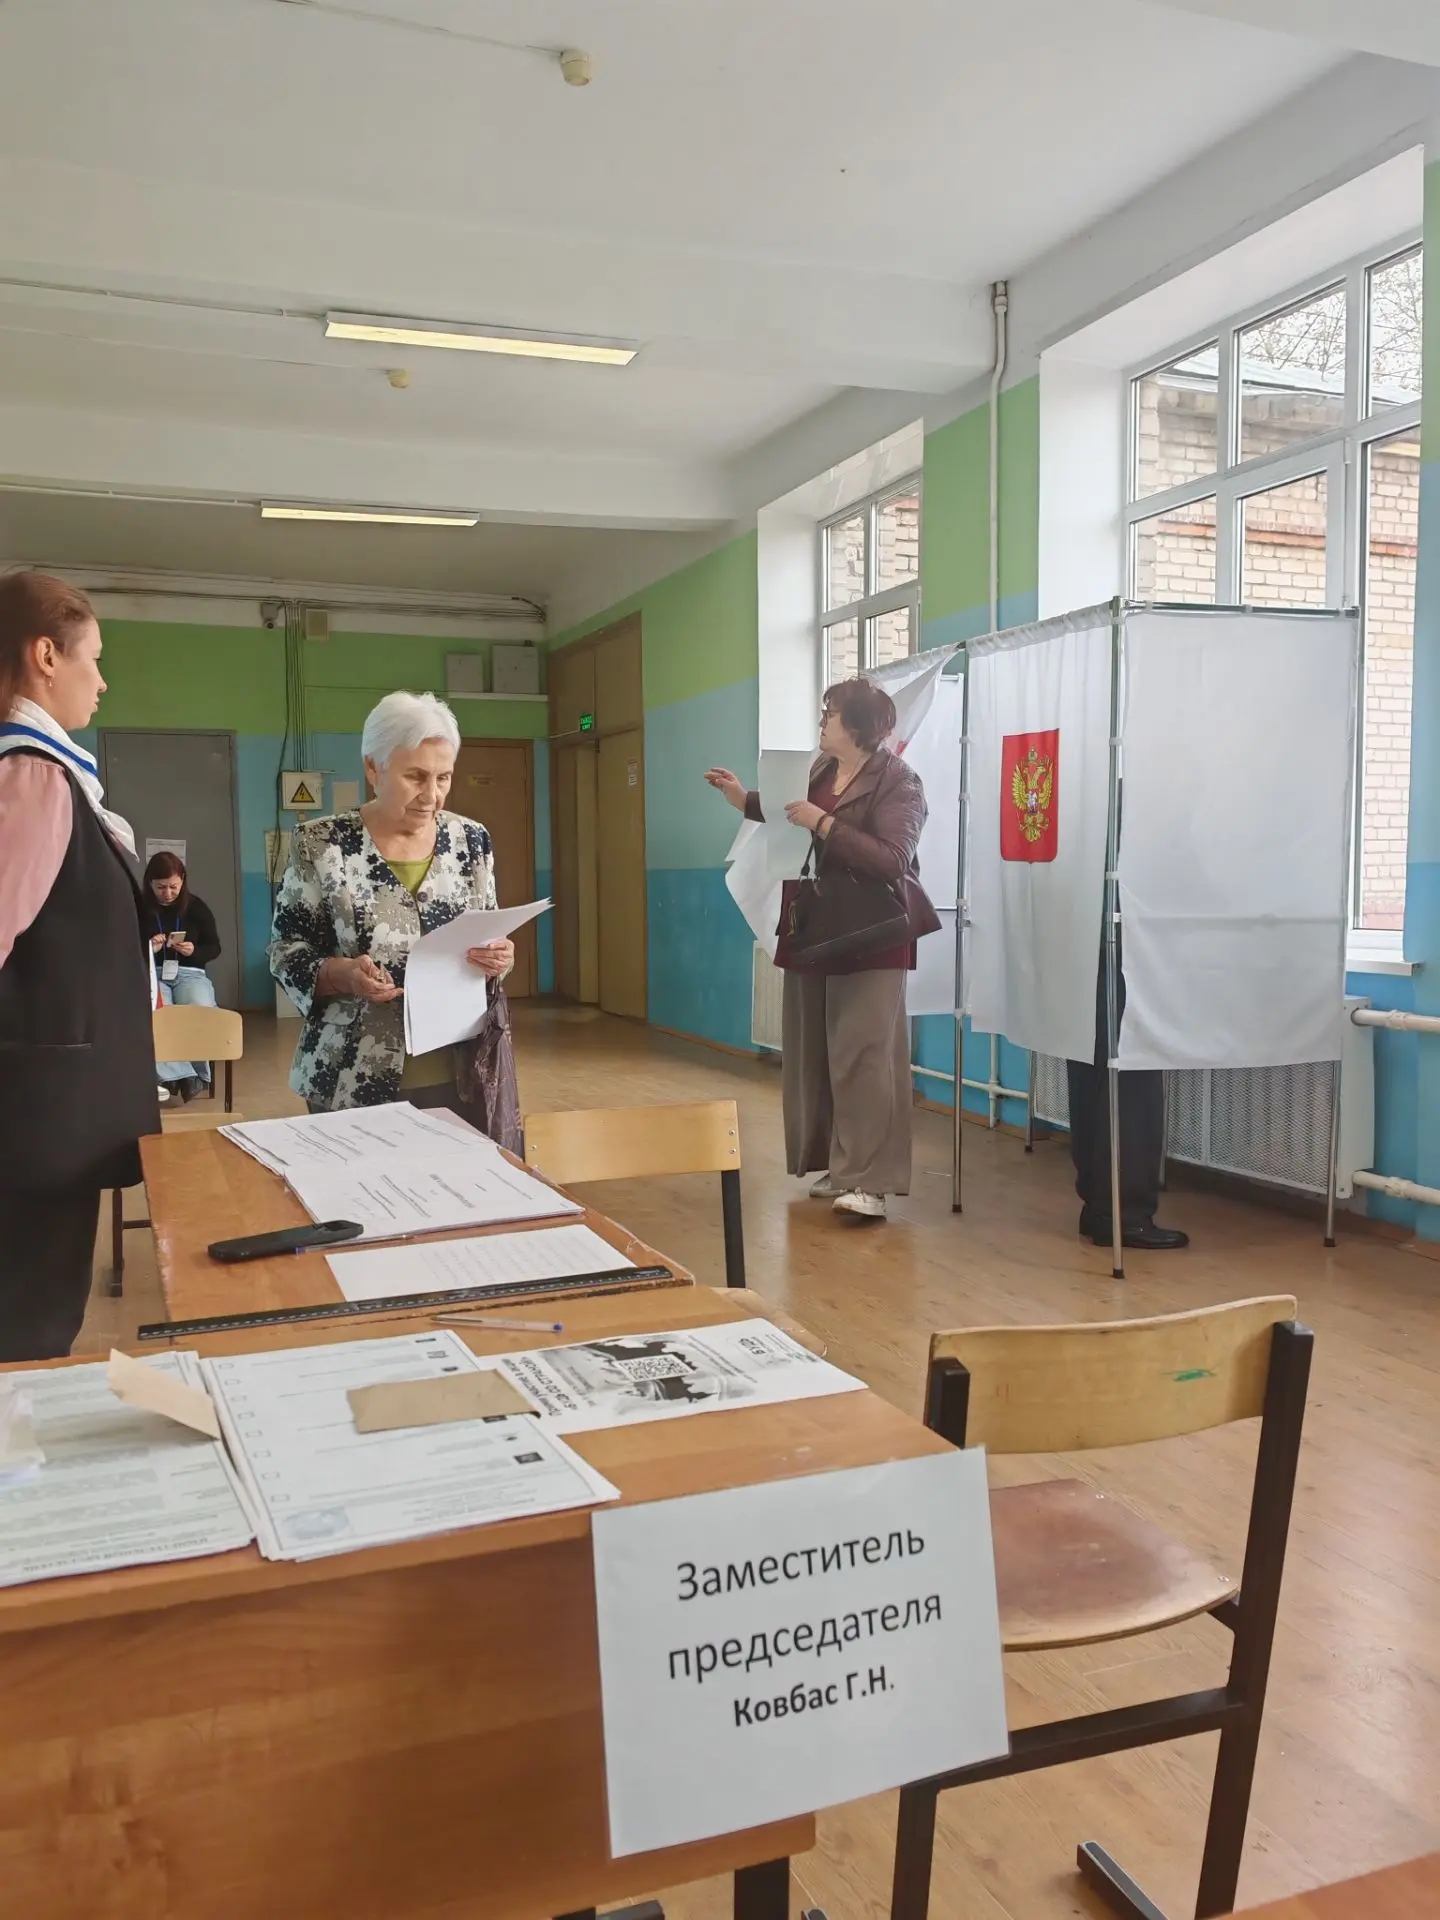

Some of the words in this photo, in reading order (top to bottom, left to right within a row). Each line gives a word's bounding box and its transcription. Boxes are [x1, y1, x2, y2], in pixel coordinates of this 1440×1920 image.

[677, 1529, 925, 1601] Заместитель
[668, 1594, 942, 1683] председателя
[733, 1683, 839, 1727] Ковбас
[846, 1665, 896, 1701] Г.Н.
